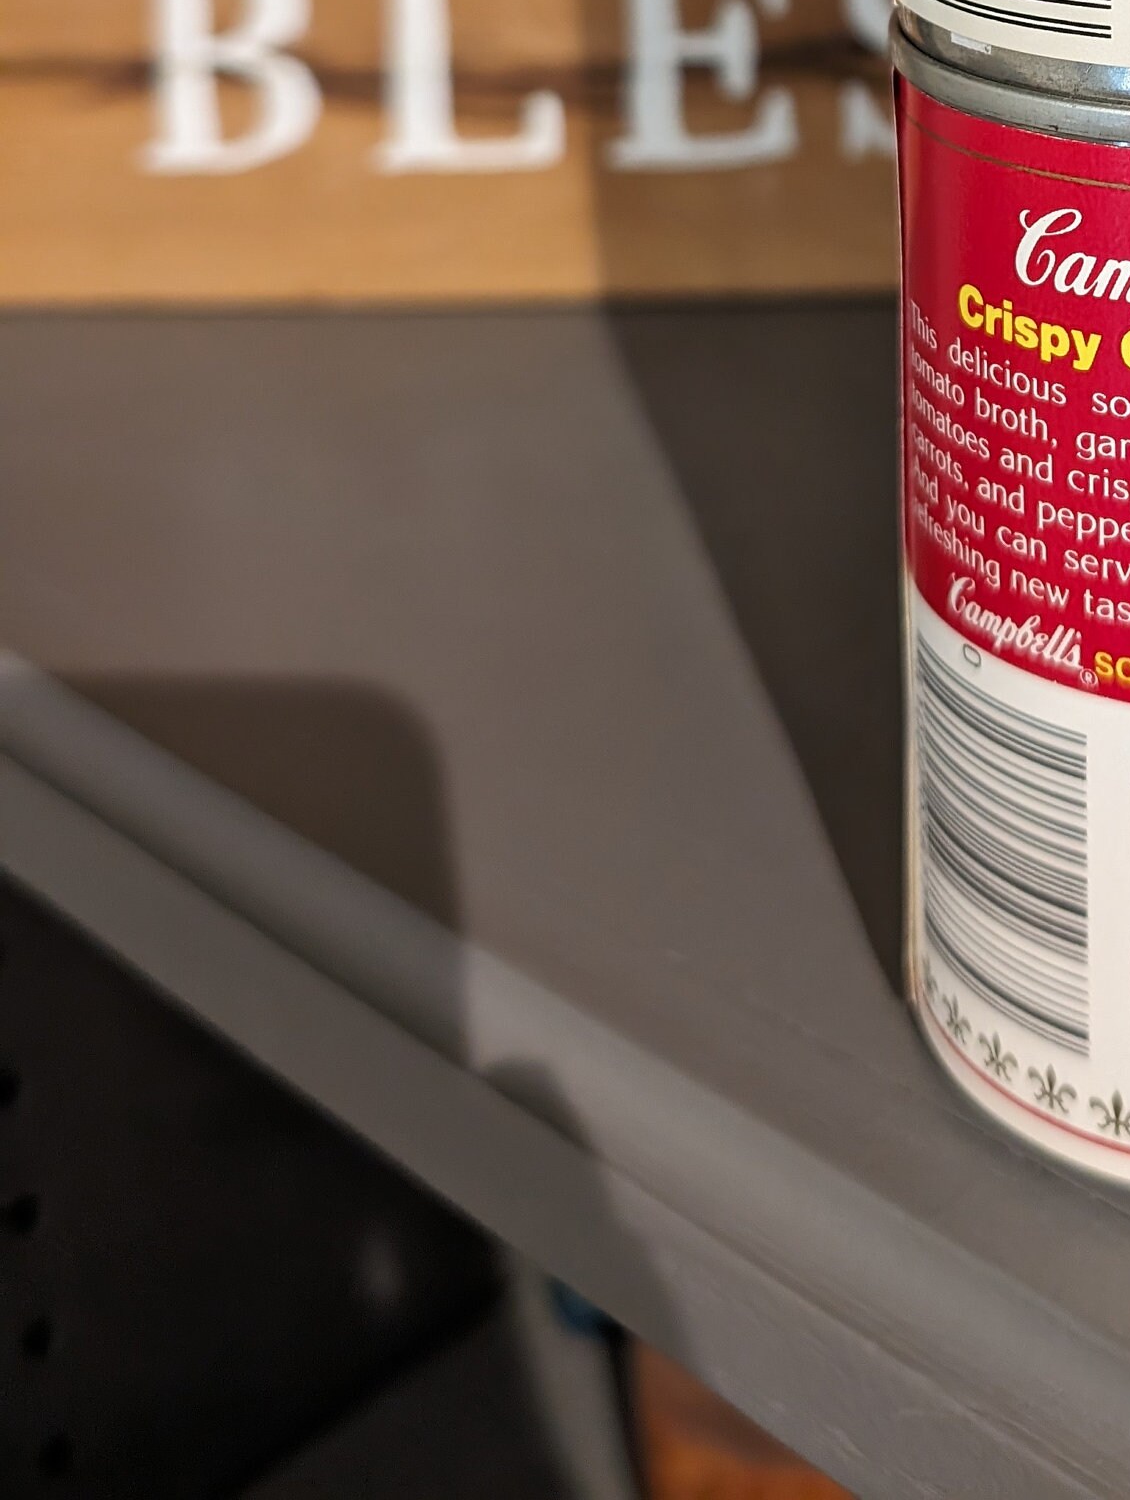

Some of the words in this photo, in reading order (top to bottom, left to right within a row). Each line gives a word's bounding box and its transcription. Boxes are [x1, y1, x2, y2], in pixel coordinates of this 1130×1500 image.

[910, 301, 938, 350] This
[949, 336, 1067, 405] delicious
[958, 283, 1101, 374] Crispy
[913, 499, 1000, 589] refreshing
[1011, 566, 1072, 610] new
